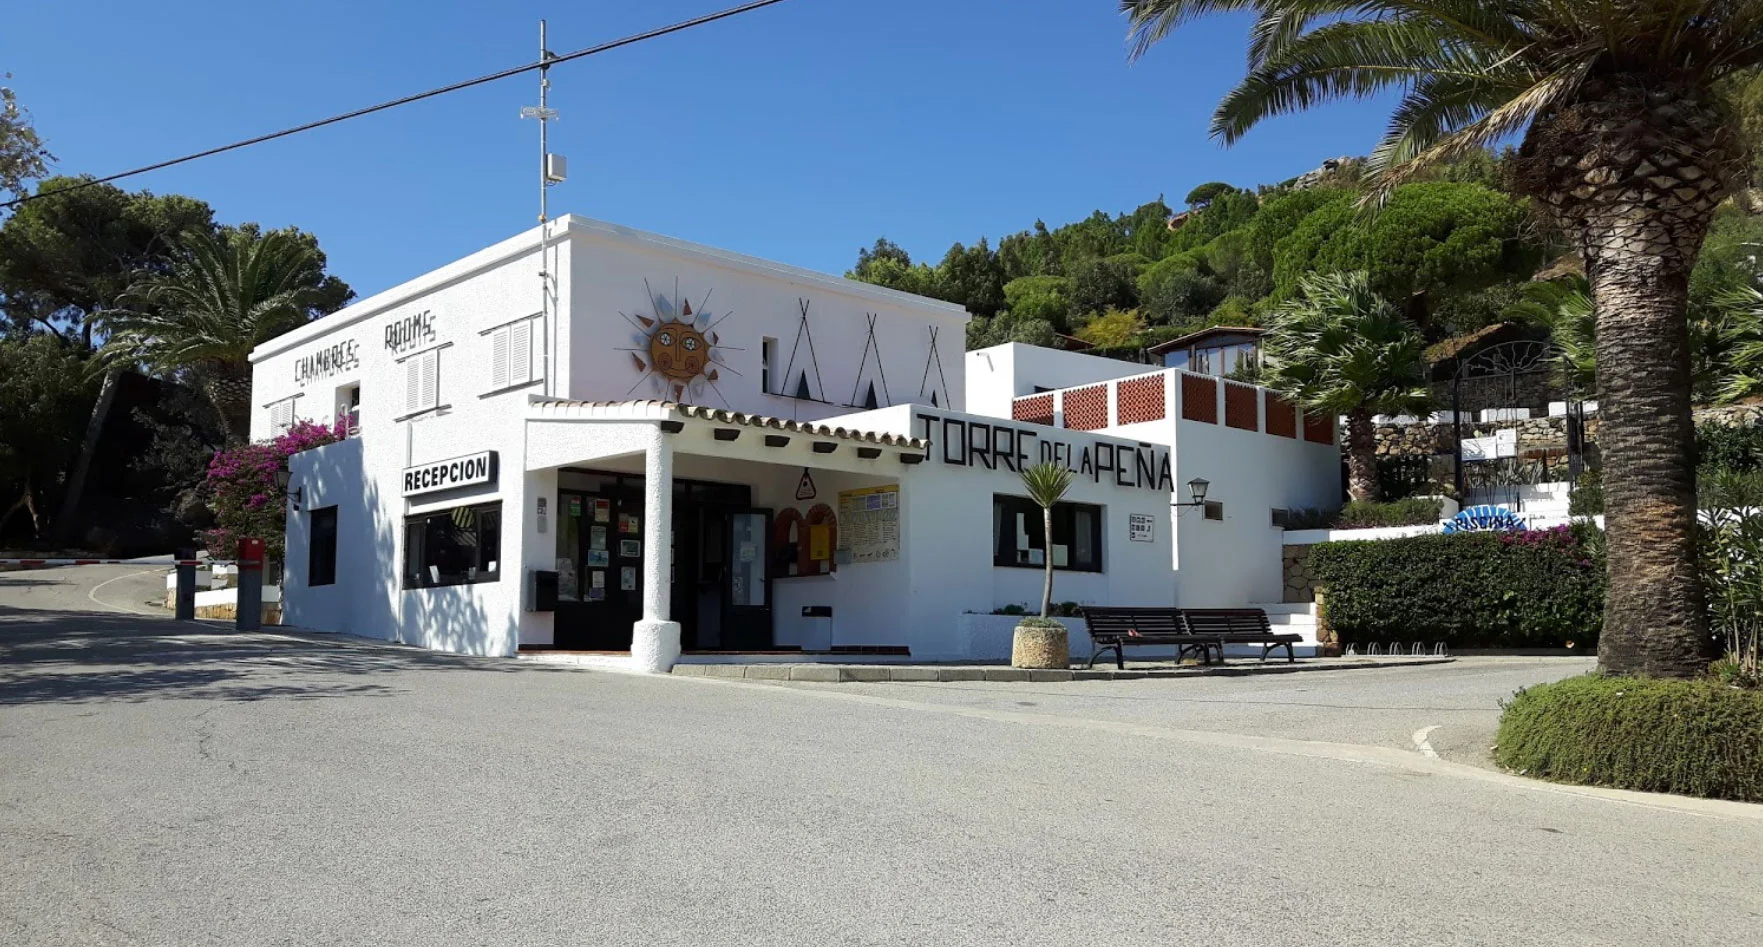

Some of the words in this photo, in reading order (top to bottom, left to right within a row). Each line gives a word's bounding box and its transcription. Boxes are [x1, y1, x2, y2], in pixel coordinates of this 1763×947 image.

[385, 309, 432, 350] ROOMS
[294, 338, 356, 382] CHAMBRES
[917, 413, 1038, 474] TORRE
[1095, 441, 1175, 493] PEÑA
[404, 456, 487, 492] RECEPCION
[1455, 515, 1515, 531] PISCINA
